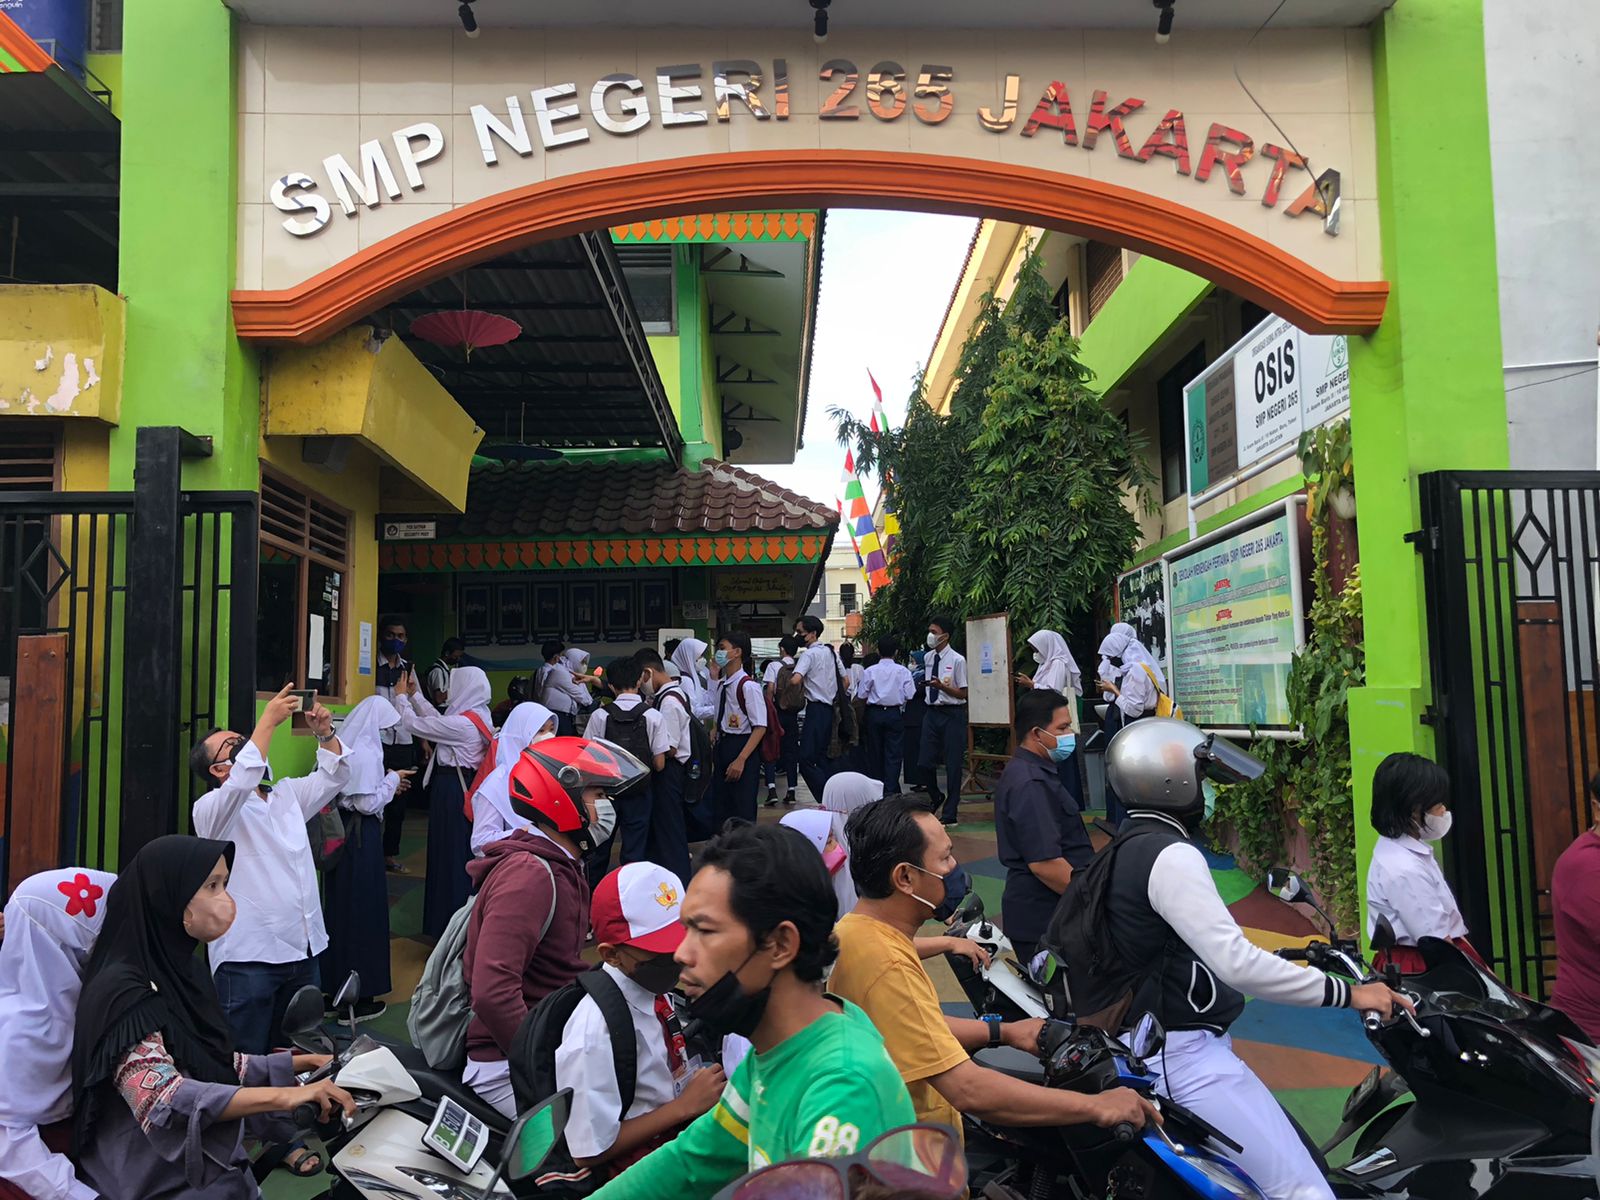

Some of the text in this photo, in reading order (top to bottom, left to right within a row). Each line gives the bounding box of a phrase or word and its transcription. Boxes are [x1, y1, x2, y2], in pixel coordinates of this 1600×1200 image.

[270, 58, 1341, 237] SMP NEGERI 265 JAKARTA
[1254, 339, 1295, 404] OSIS
[1316, 382, 1328, 398] SMP
[1330, 369, 1349, 389] NEGE
[1255, 411, 1266, 428] SMP
[1267, 397, 1287, 421] NEGERI
[1288, 389, 1298, 408] 265
[1264, 531, 1284, 550] JAKARTA
[808, 1115, 860, 1158] 88
